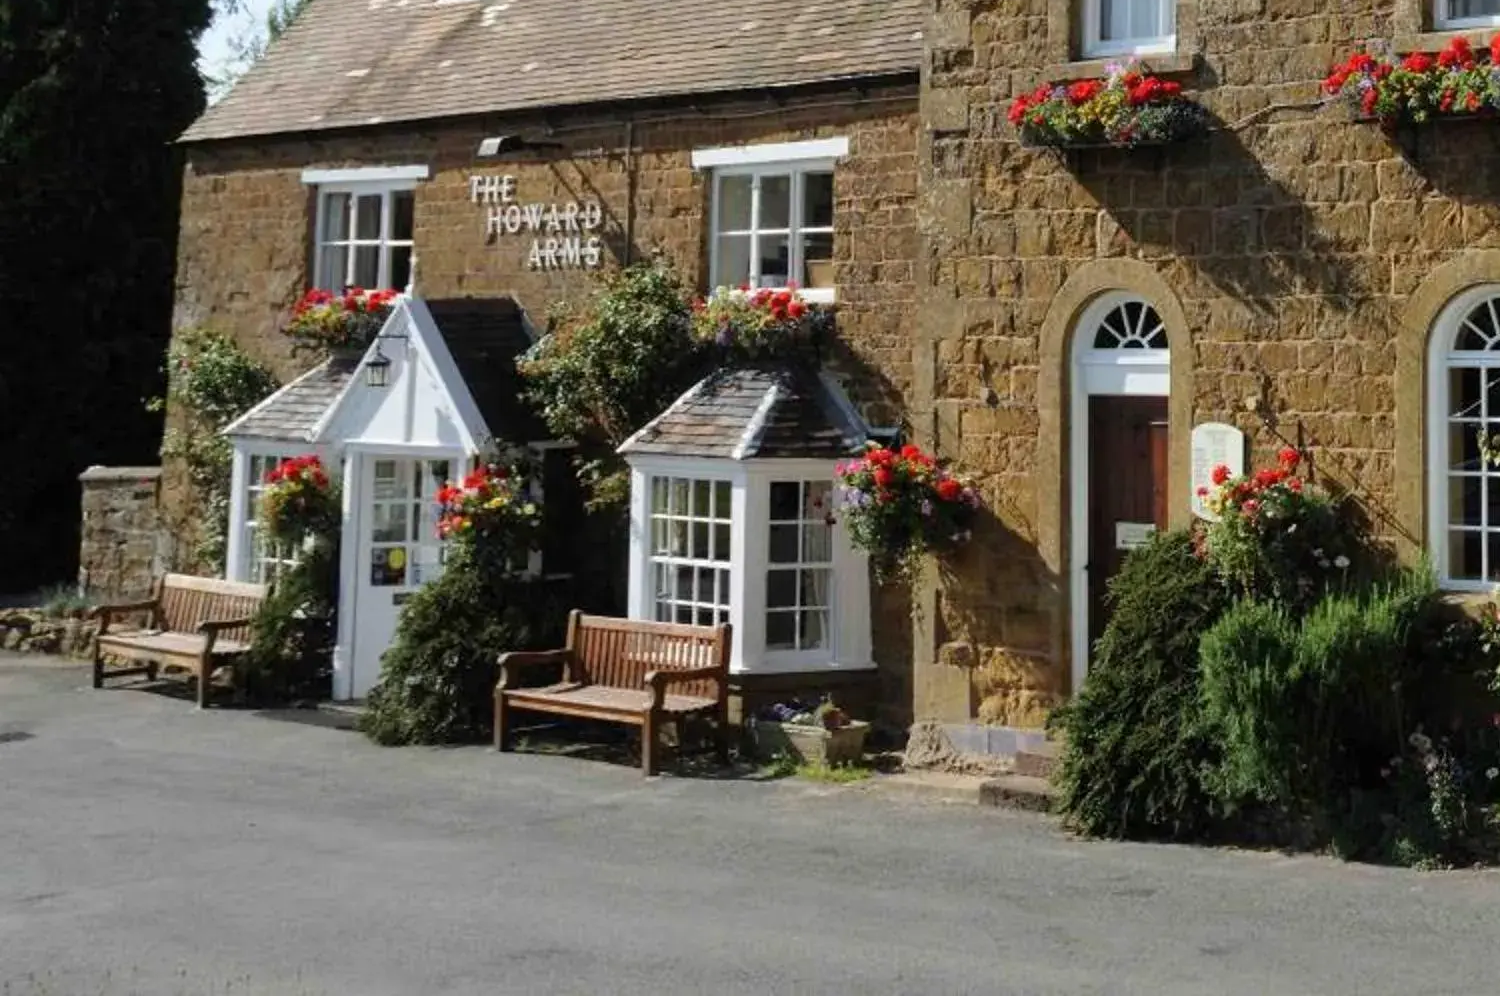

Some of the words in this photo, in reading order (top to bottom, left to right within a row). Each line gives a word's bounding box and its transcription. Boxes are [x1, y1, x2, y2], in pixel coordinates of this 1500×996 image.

[469, 175, 516, 203] THE
[487, 202, 602, 234] HOWARD
[528, 237, 600, 267] ARMS
